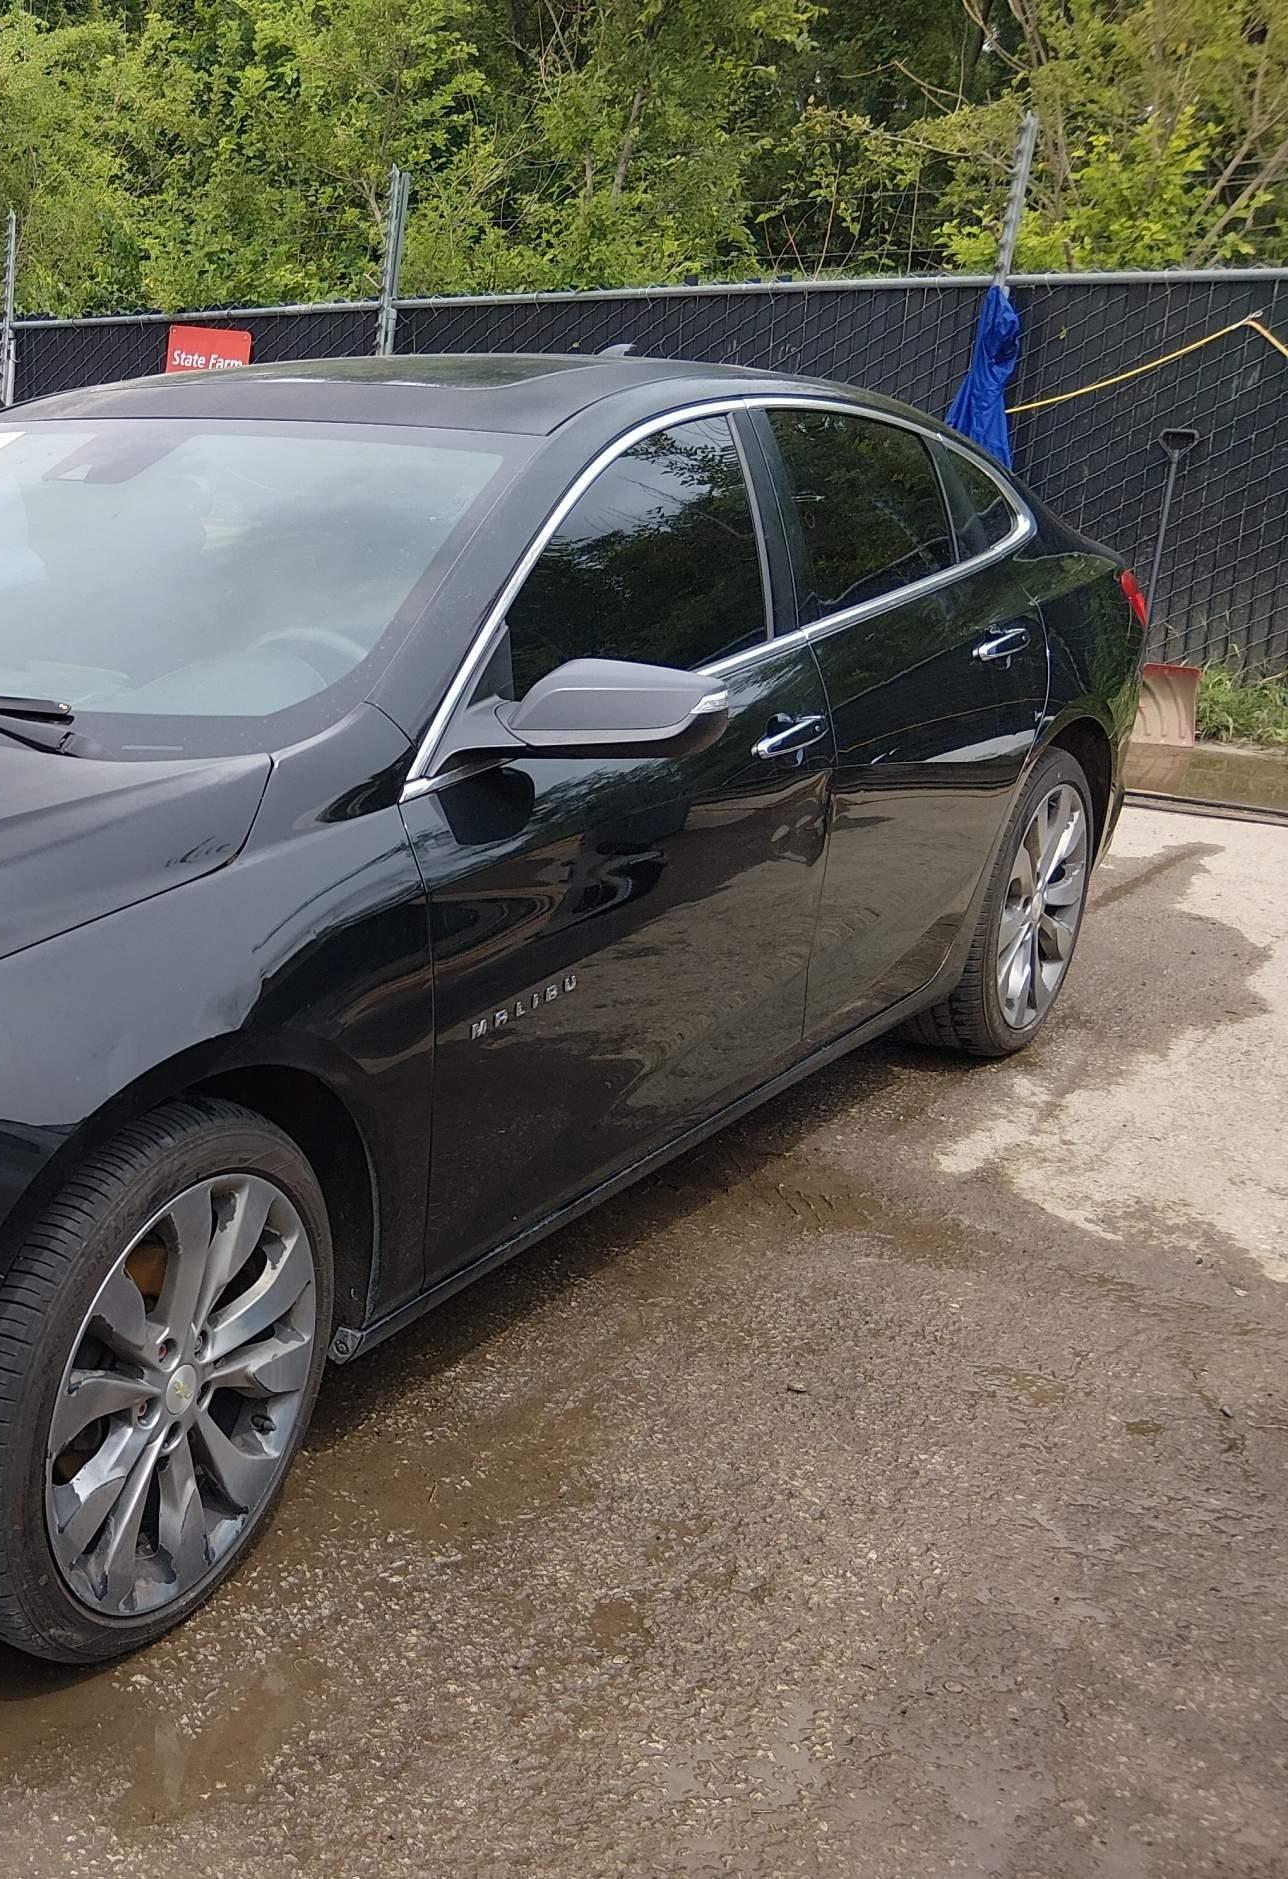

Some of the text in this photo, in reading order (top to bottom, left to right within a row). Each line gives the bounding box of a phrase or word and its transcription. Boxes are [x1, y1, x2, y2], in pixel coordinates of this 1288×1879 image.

[172, 350, 243, 370] State Farm
[471, 975, 577, 1040] MALIBU
